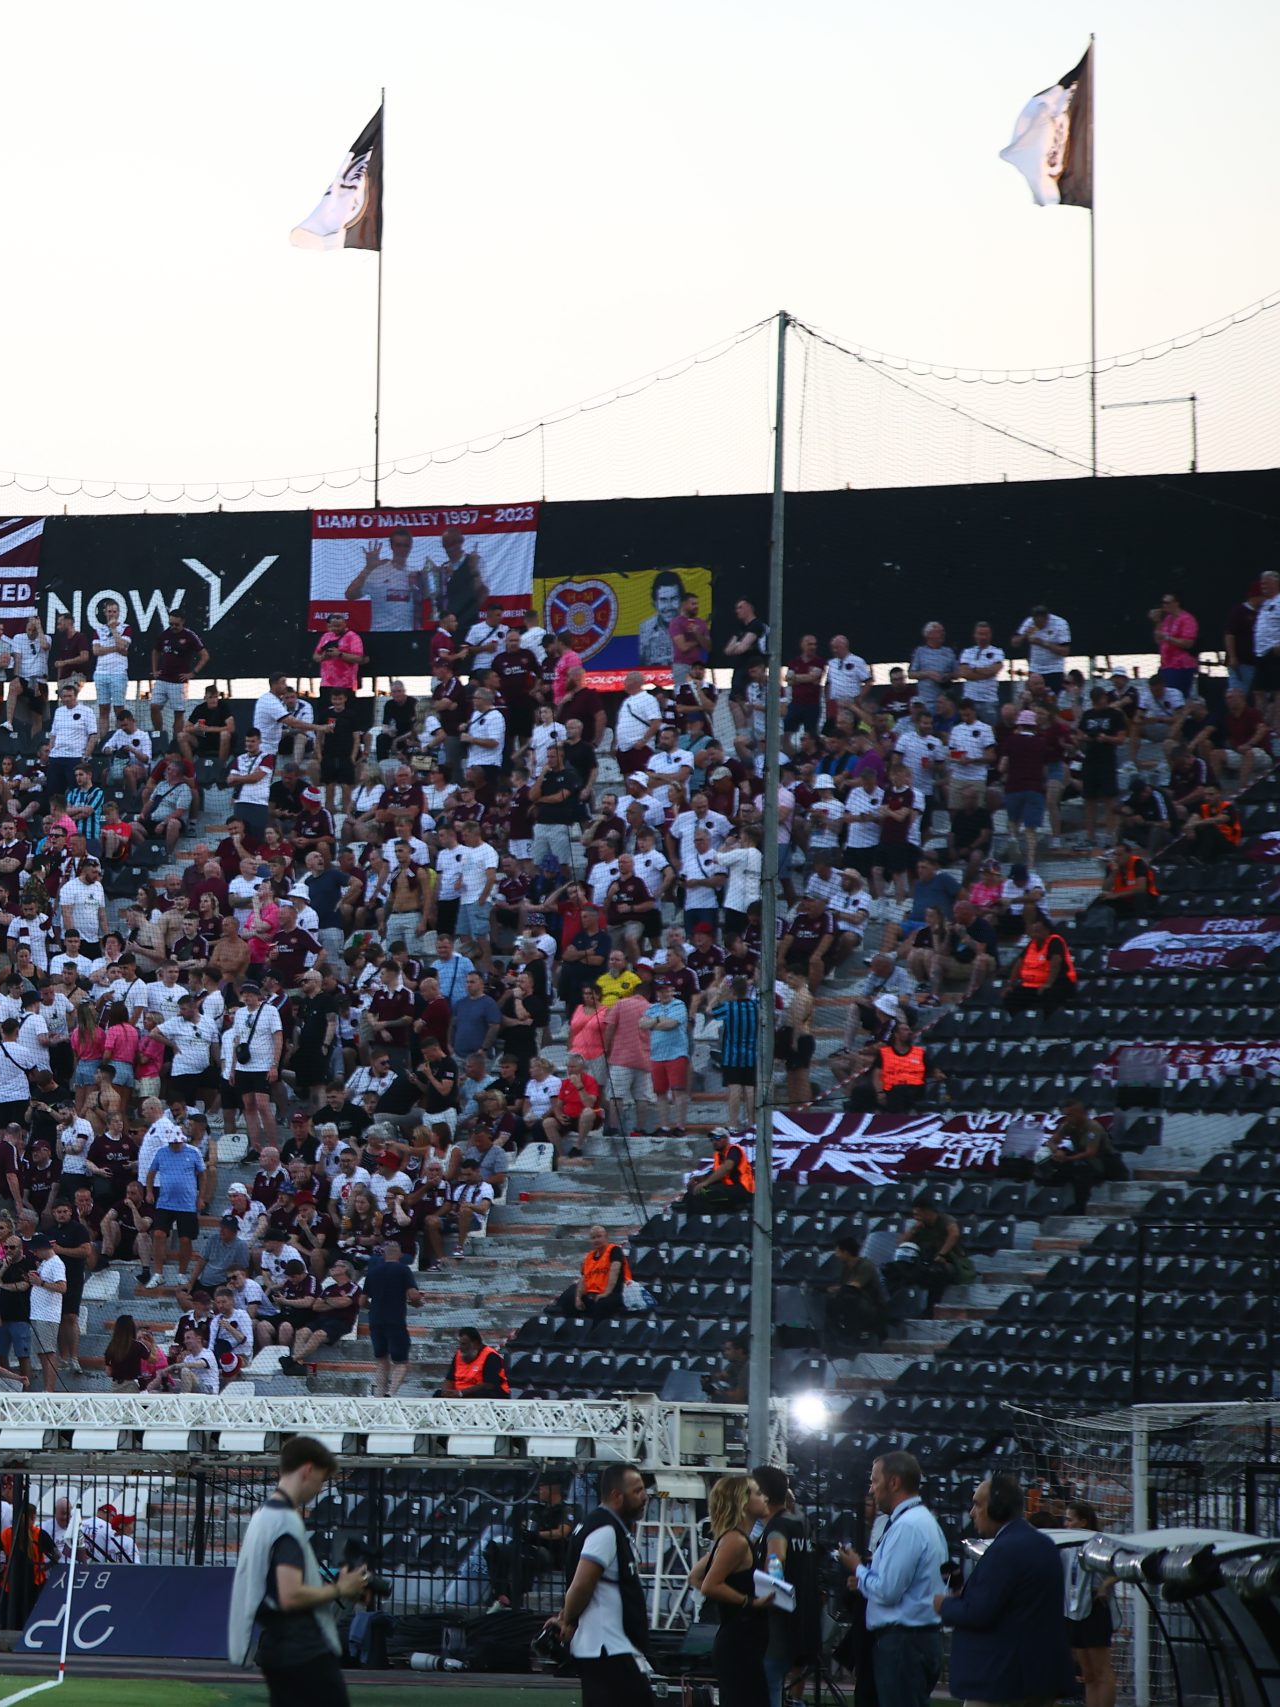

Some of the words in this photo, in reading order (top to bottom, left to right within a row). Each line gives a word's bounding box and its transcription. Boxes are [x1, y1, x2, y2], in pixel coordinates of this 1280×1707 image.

[317, 514, 356, 528] LIAM
[359, 512, 439, 528] O'MALLEY
[442, 510, 479, 525] 1997
[494, 507, 534, 522] 2023
[1200, 918, 1267, 932] FERRY
